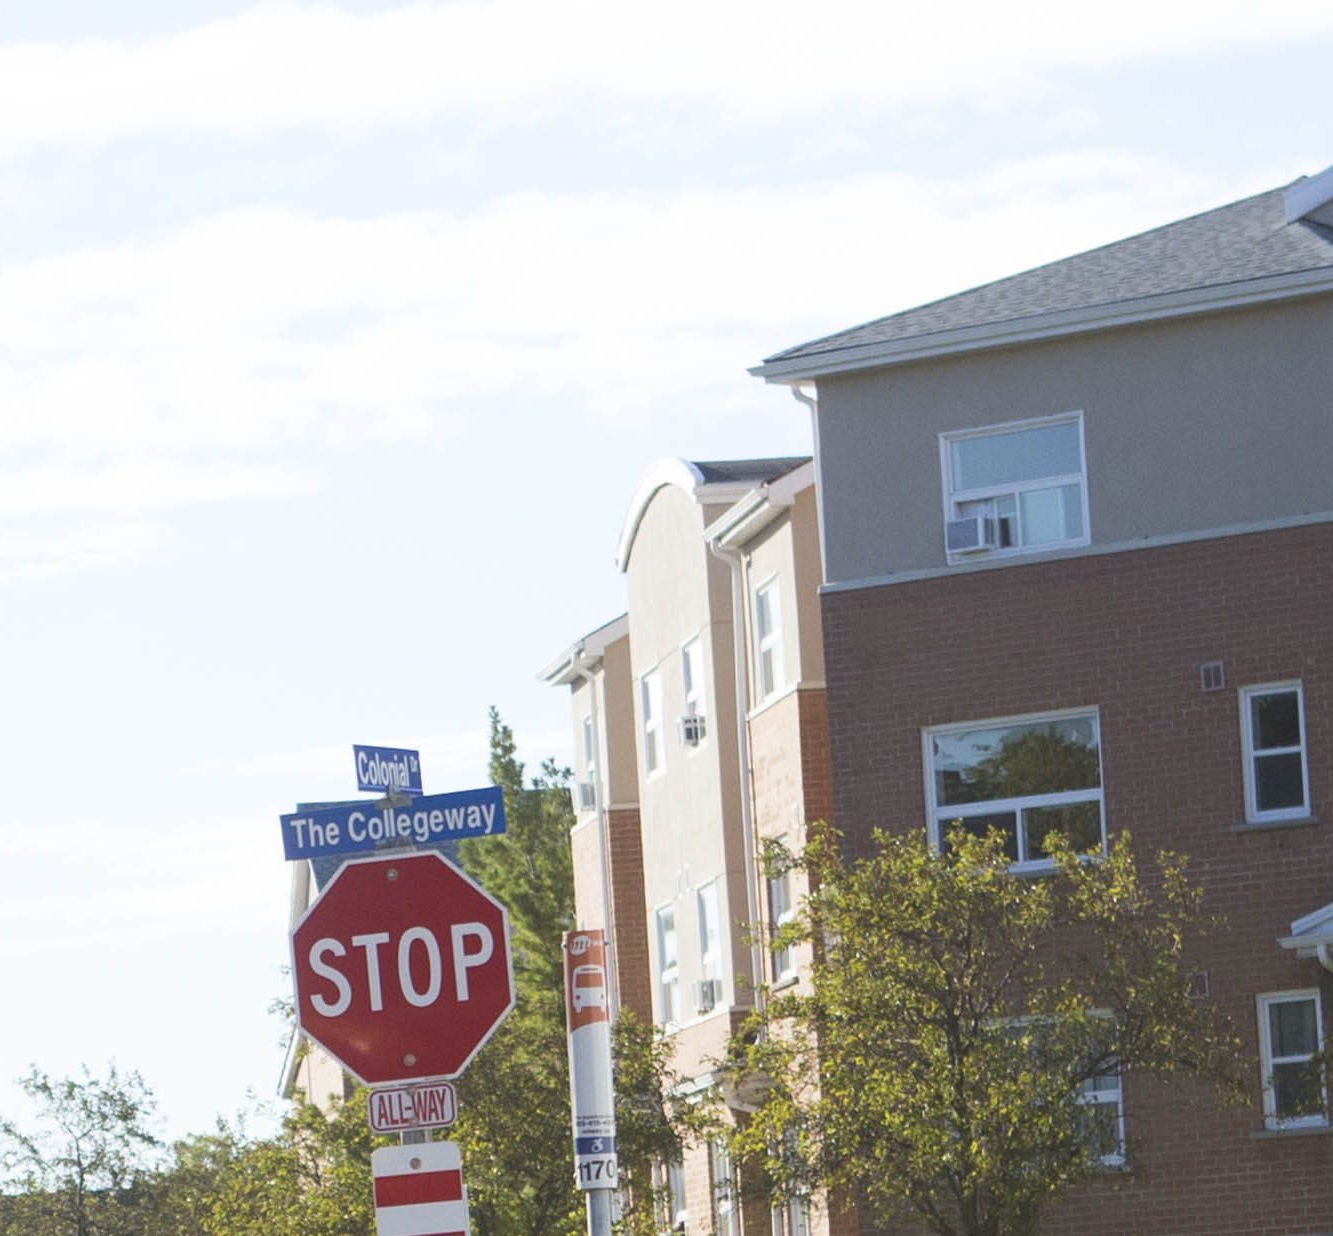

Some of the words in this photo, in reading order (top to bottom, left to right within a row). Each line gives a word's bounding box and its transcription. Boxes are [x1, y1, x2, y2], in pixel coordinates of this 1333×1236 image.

[358, 751, 410, 788] Colonial
[290, 819, 341, 849] The
[348, 803, 496, 843] Collegeway
[308, 921, 495, 1018] STOP
[378, 1088, 447, 1127] ALL-WAY
